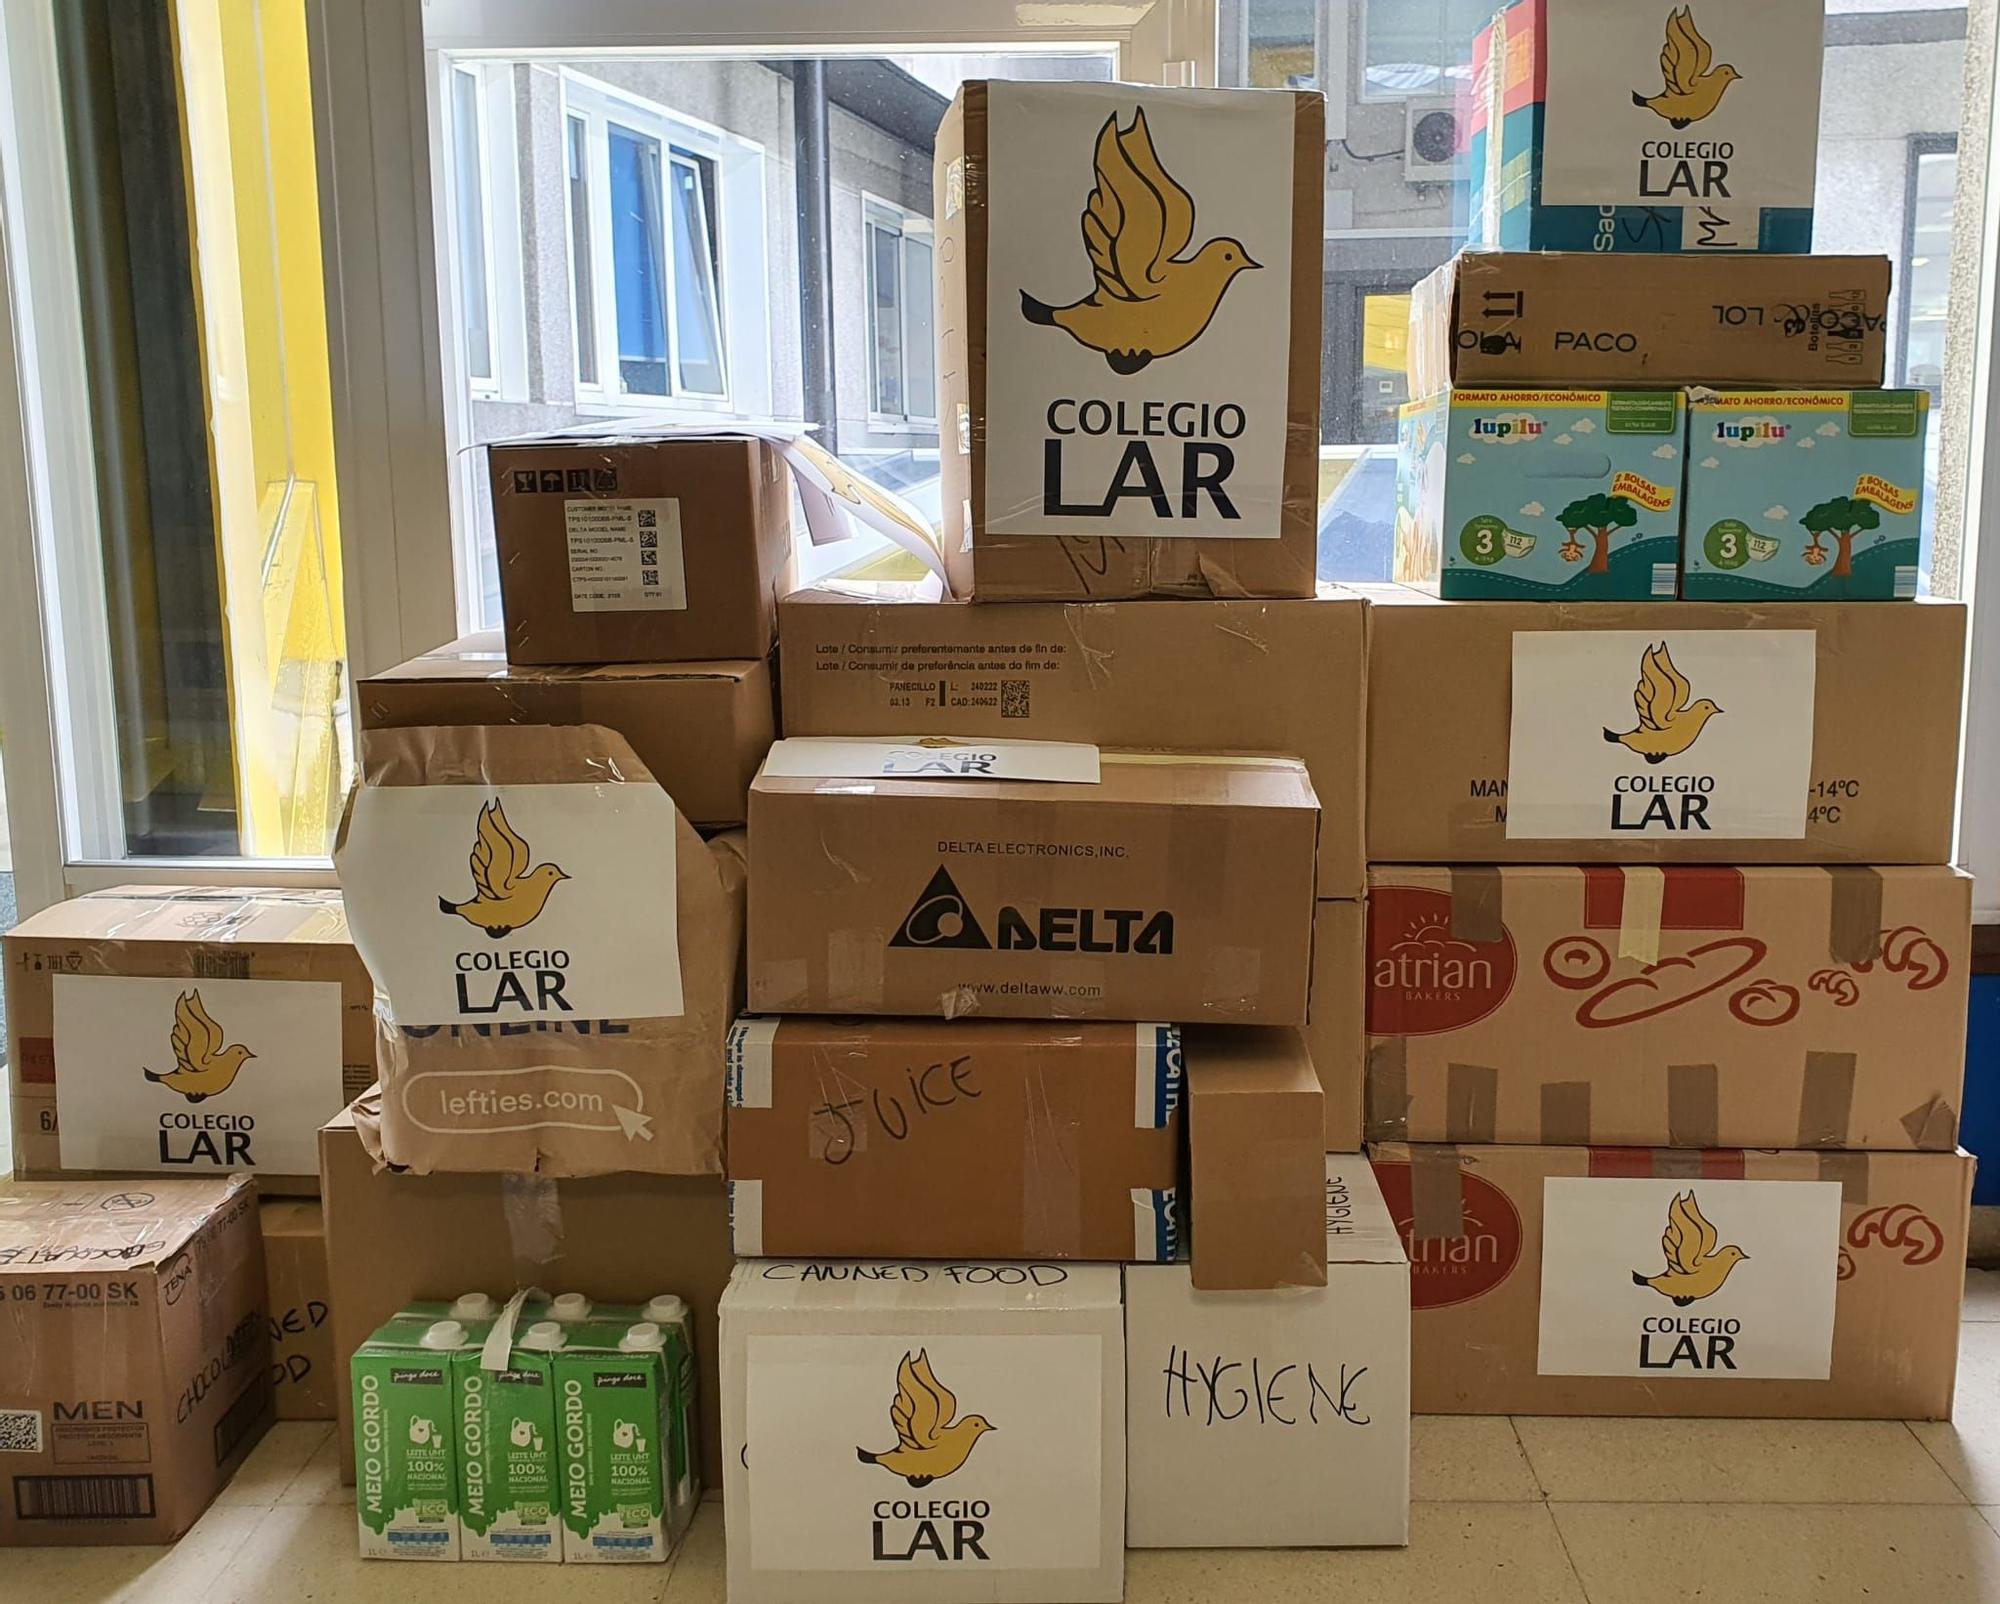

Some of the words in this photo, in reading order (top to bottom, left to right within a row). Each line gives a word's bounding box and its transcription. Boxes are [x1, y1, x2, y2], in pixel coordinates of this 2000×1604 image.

[1641, 141, 1734, 160] COLEGIO
[1639, 160, 1732, 198] LAR
[1554, 331, 1638, 352] PACO
[1453, 392, 1498, 402] FORMATO
[1046, 399, 1247, 439] COLEGIO
[1474, 418, 1543, 438] lupilu
[1717, 421, 1786, 442] lupilu
[1043, 439, 1242, 520] LAR
[1624, 472, 1657, 495] BOLSAS
[1867, 475, 1899, 498] BOLSAS
[1612, 482, 1672, 507] EMBALAGENS
[1855, 486, 1914, 509] EMBALAGENS
[1476, 529, 1493, 554] 3
[1510, 535, 1522, 546] 112
[1720, 533, 1737, 558] 3
[1753, 540, 1766, 549] 112
[816, 644, 839, 654] Lote
[848, 644, 898, 654] Consumir
[901, 644, 986, 655] preferentemente
[988, 645, 1016, 654] antes
[1019, 644, 1033, 654] de
[1035, 644, 1047, 654] fin
[1050, 644, 1067, 654] de:
[816, 661, 839, 671] Lote
[848, 661, 898, 671] Consumir
[901, 661, 915, 670] de
[977, 661, 1006, 670] antes
[1008, 661, 1022, 670] do
[1025, 661, 1041, 670] fim
[1043, 661, 1060, 670] de:
[889, 682, 936, 692] PANECILLO
[882, 760, 995, 774] LAR
[888, 750, 997, 762] COLEGIO
[1613, 775, 1716, 793] COLEGIO
[1610, 794, 1711, 830] LAR
[937, 841, 984, 854] DELTA
[997, 905, 1174, 955] DELTA
[455, 949, 570, 971] COLEGIO
[1374, 952, 1492, 989] atrian
[455, 970, 574, 1014] LAR
[1405, 991, 1461, 1001] BAKERS
[439, 1089, 603, 1115] lefties.com
[159, 1113, 255, 1131] COLEGIO
[159, 1129, 257, 1166] LAR
[1406, 1228, 1499, 1263] trian
[163, 1266, 193, 1296] TENA
[762, 1264, 929, 1282] CANNED
[944, 1264, 1070, 1287] FOOD
[12, 1284, 36, 1301] 06
[42, 1283, 100, 1300] 77-00
[107, 1281, 139, 1298] SK
[1642, 1316, 1741, 1334] COLEGIO
[1639, 1334, 1738, 1370] LAR
[1163, 1344, 1371, 1426] HYGIENE
[53, 1400, 143, 1420] MEN
[361, 1374, 381, 1454] GORDO
[463, 1376, 483, 1457] GORDO
[564, 1380, 583, 1459] GORDO
[406, 1461, 445, 1473] 100%
[406, 1472, 447, 1481] NACIONAL
[508, 1464, 546, 1475] 100%
[611, 1465, 648, 1477] 100%
[364, 1457, 383, 1514] MEIO
[466, 1460, 485, 1516] MEIO
[508, 1475, 548, 1483] NACIONAL
[611, 1476, 651, 1484] NACIONAL
[568, 1463, 588, 1519] MEIO
[873, 1500, 990, 1520] COLEGIO
[872, 1520, 990, 1561] LAR
